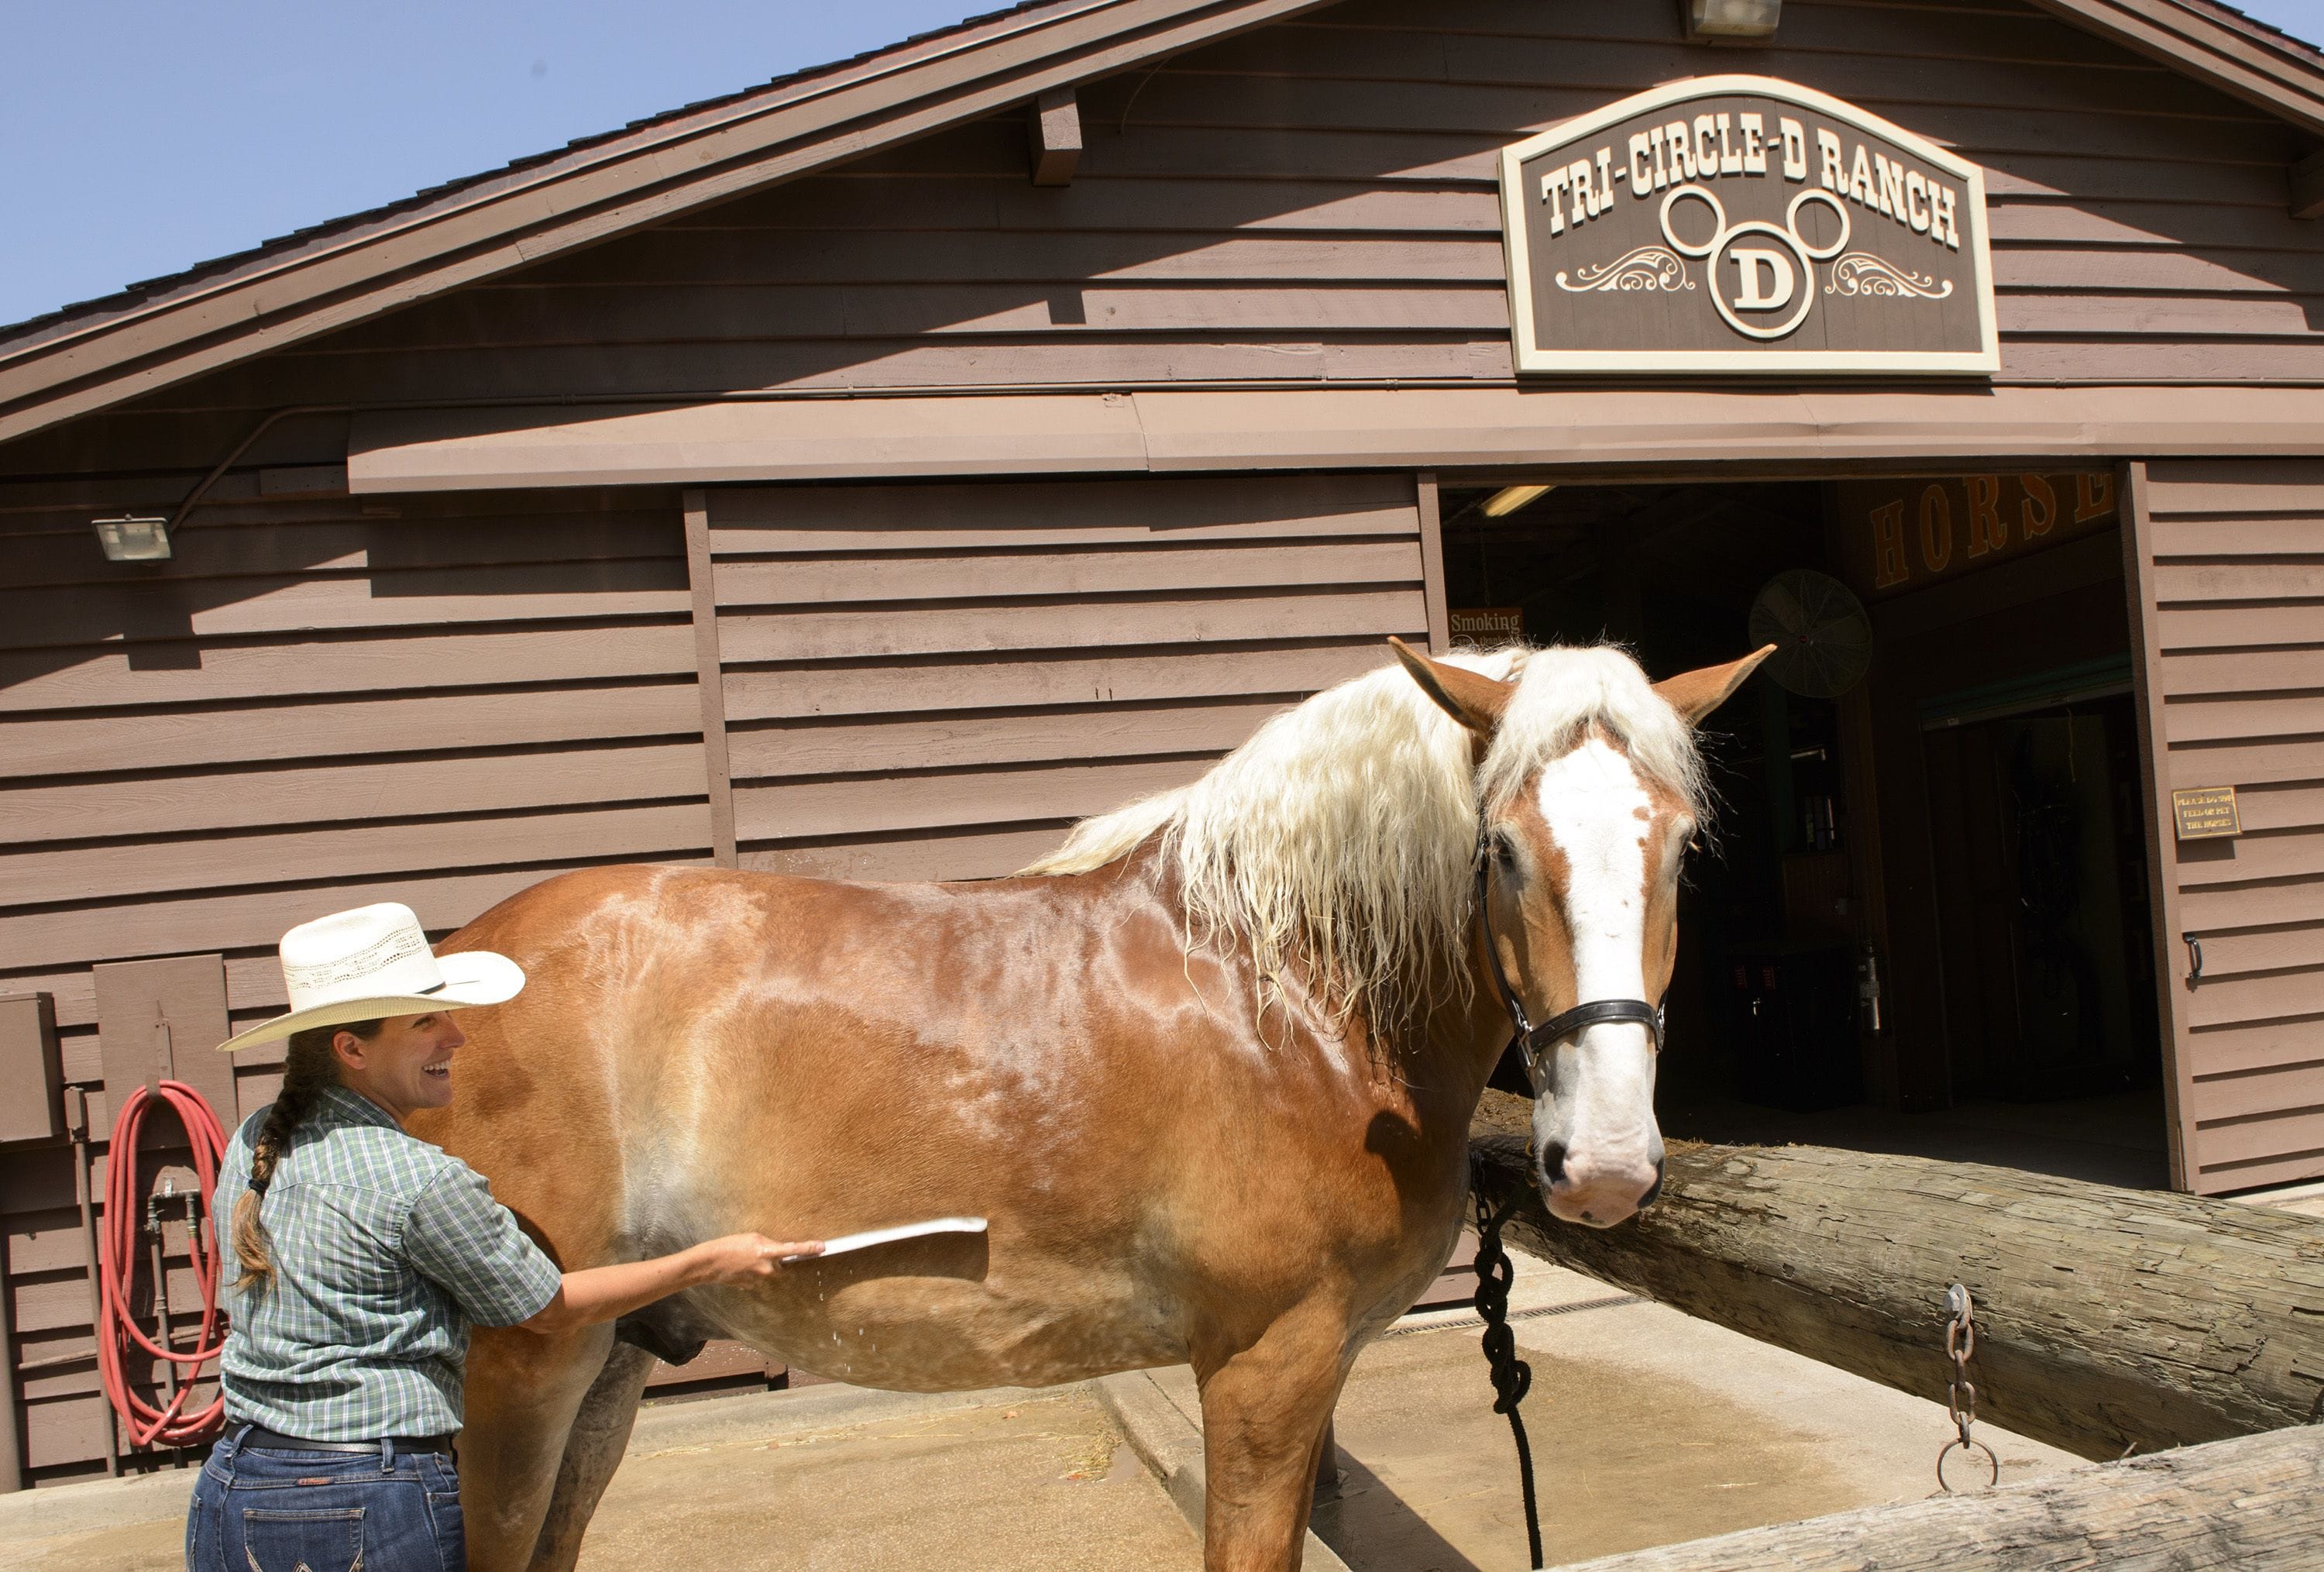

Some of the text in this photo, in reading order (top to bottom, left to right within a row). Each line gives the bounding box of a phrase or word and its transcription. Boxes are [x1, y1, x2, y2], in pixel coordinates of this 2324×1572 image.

[1541, 112, 1960, 249] TRI-CIRCLE-D RANCH
[1731, 249, 1794, 310] D
[1451, 613, 1520, 635] Smoking
